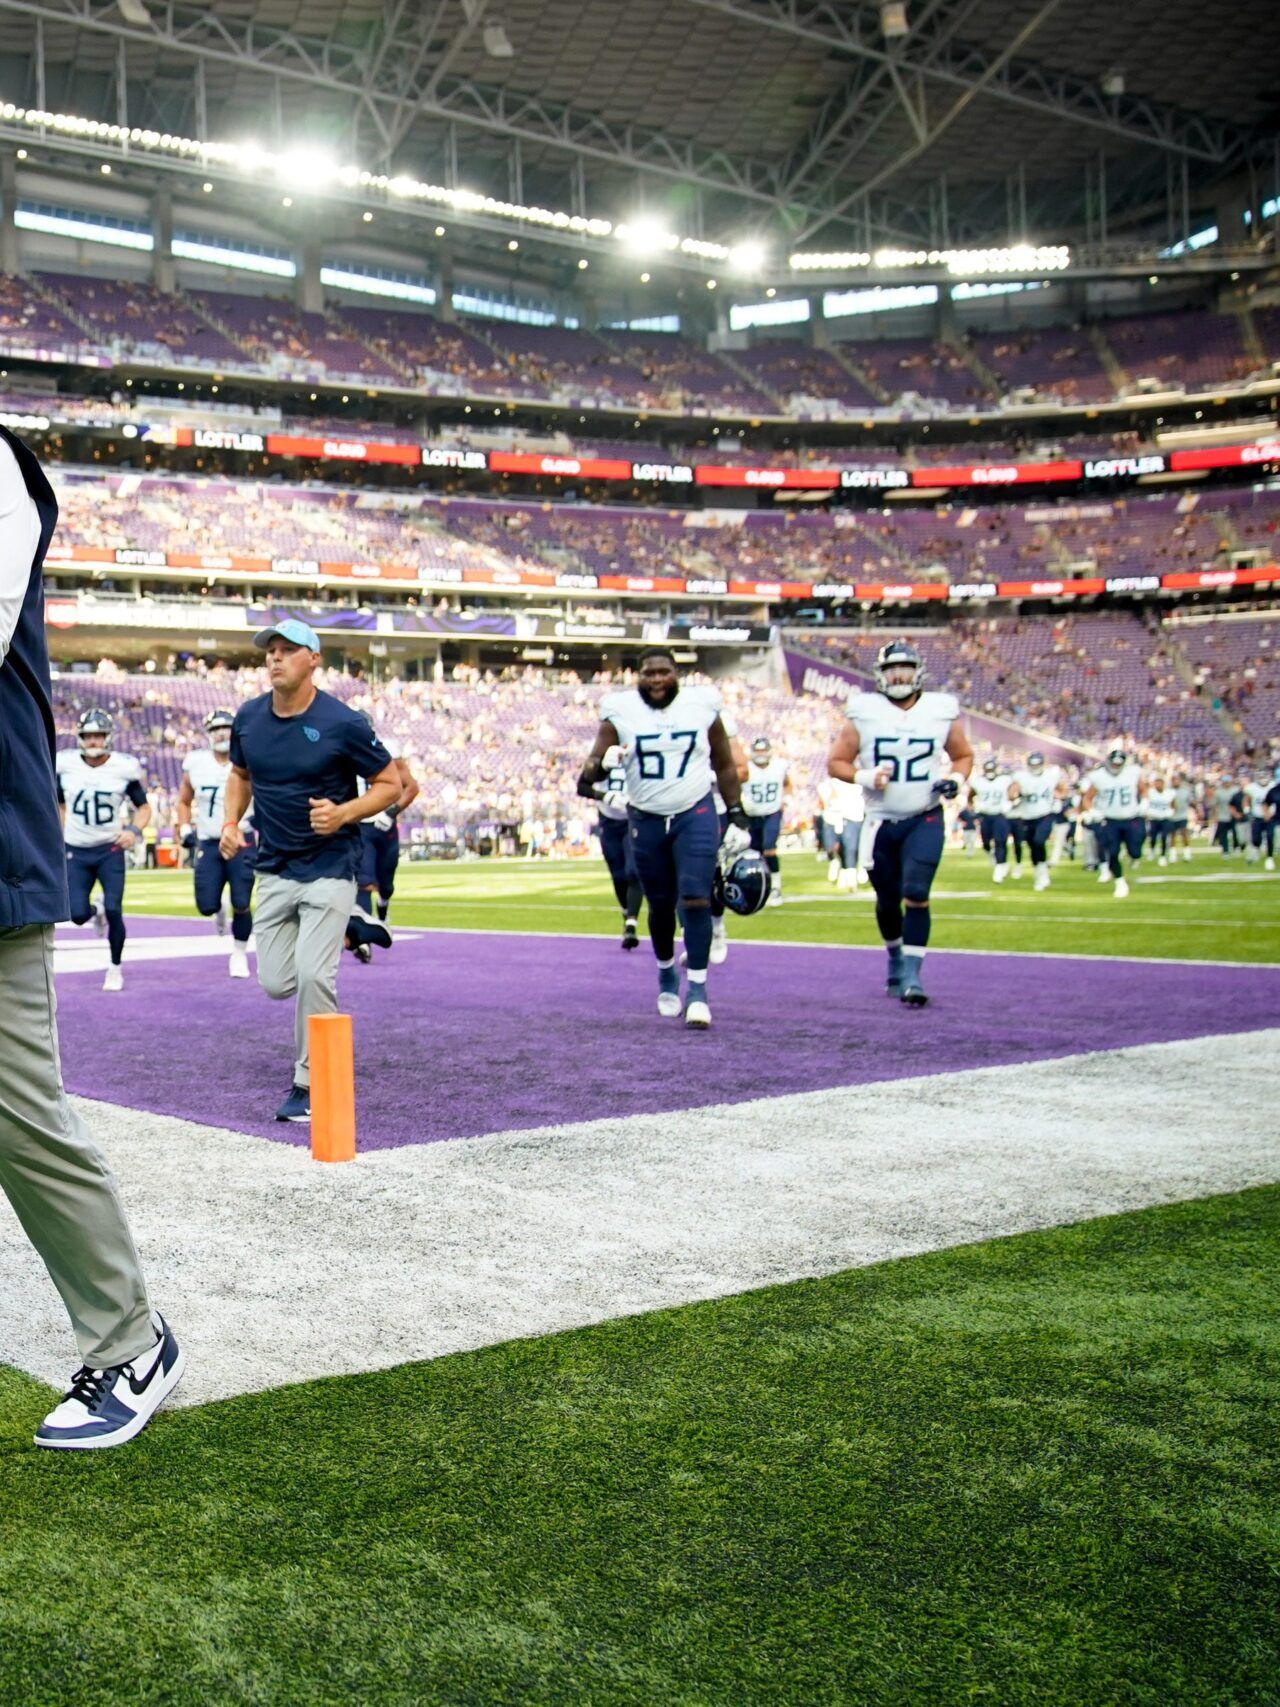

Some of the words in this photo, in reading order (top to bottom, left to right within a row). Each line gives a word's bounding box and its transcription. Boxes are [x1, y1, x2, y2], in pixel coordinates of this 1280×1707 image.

[195, 430, 264, 452] LOFFLER
[323, 442, 367, 459] CLOUD
[422, 450, 486, 469] LOFFLER
[632, 463, 693, 483] LOFFLER
[840, 470, 908, 487] LOFFLER
[971, 467, 1018, 483] CLOUD
[1084, 456, 1165, 479] LOFFLER
[116, 549, 166, 565] LOFFLER
[1106, 575, 1160, 592] LOFFLER
[635, 730, 698, 780] 67
[874, 737, 935, 782] 52
[73, 789, 114, 826] 46
[201, 785, 220, 818] 7
[751, 782, 778, 803] 58
